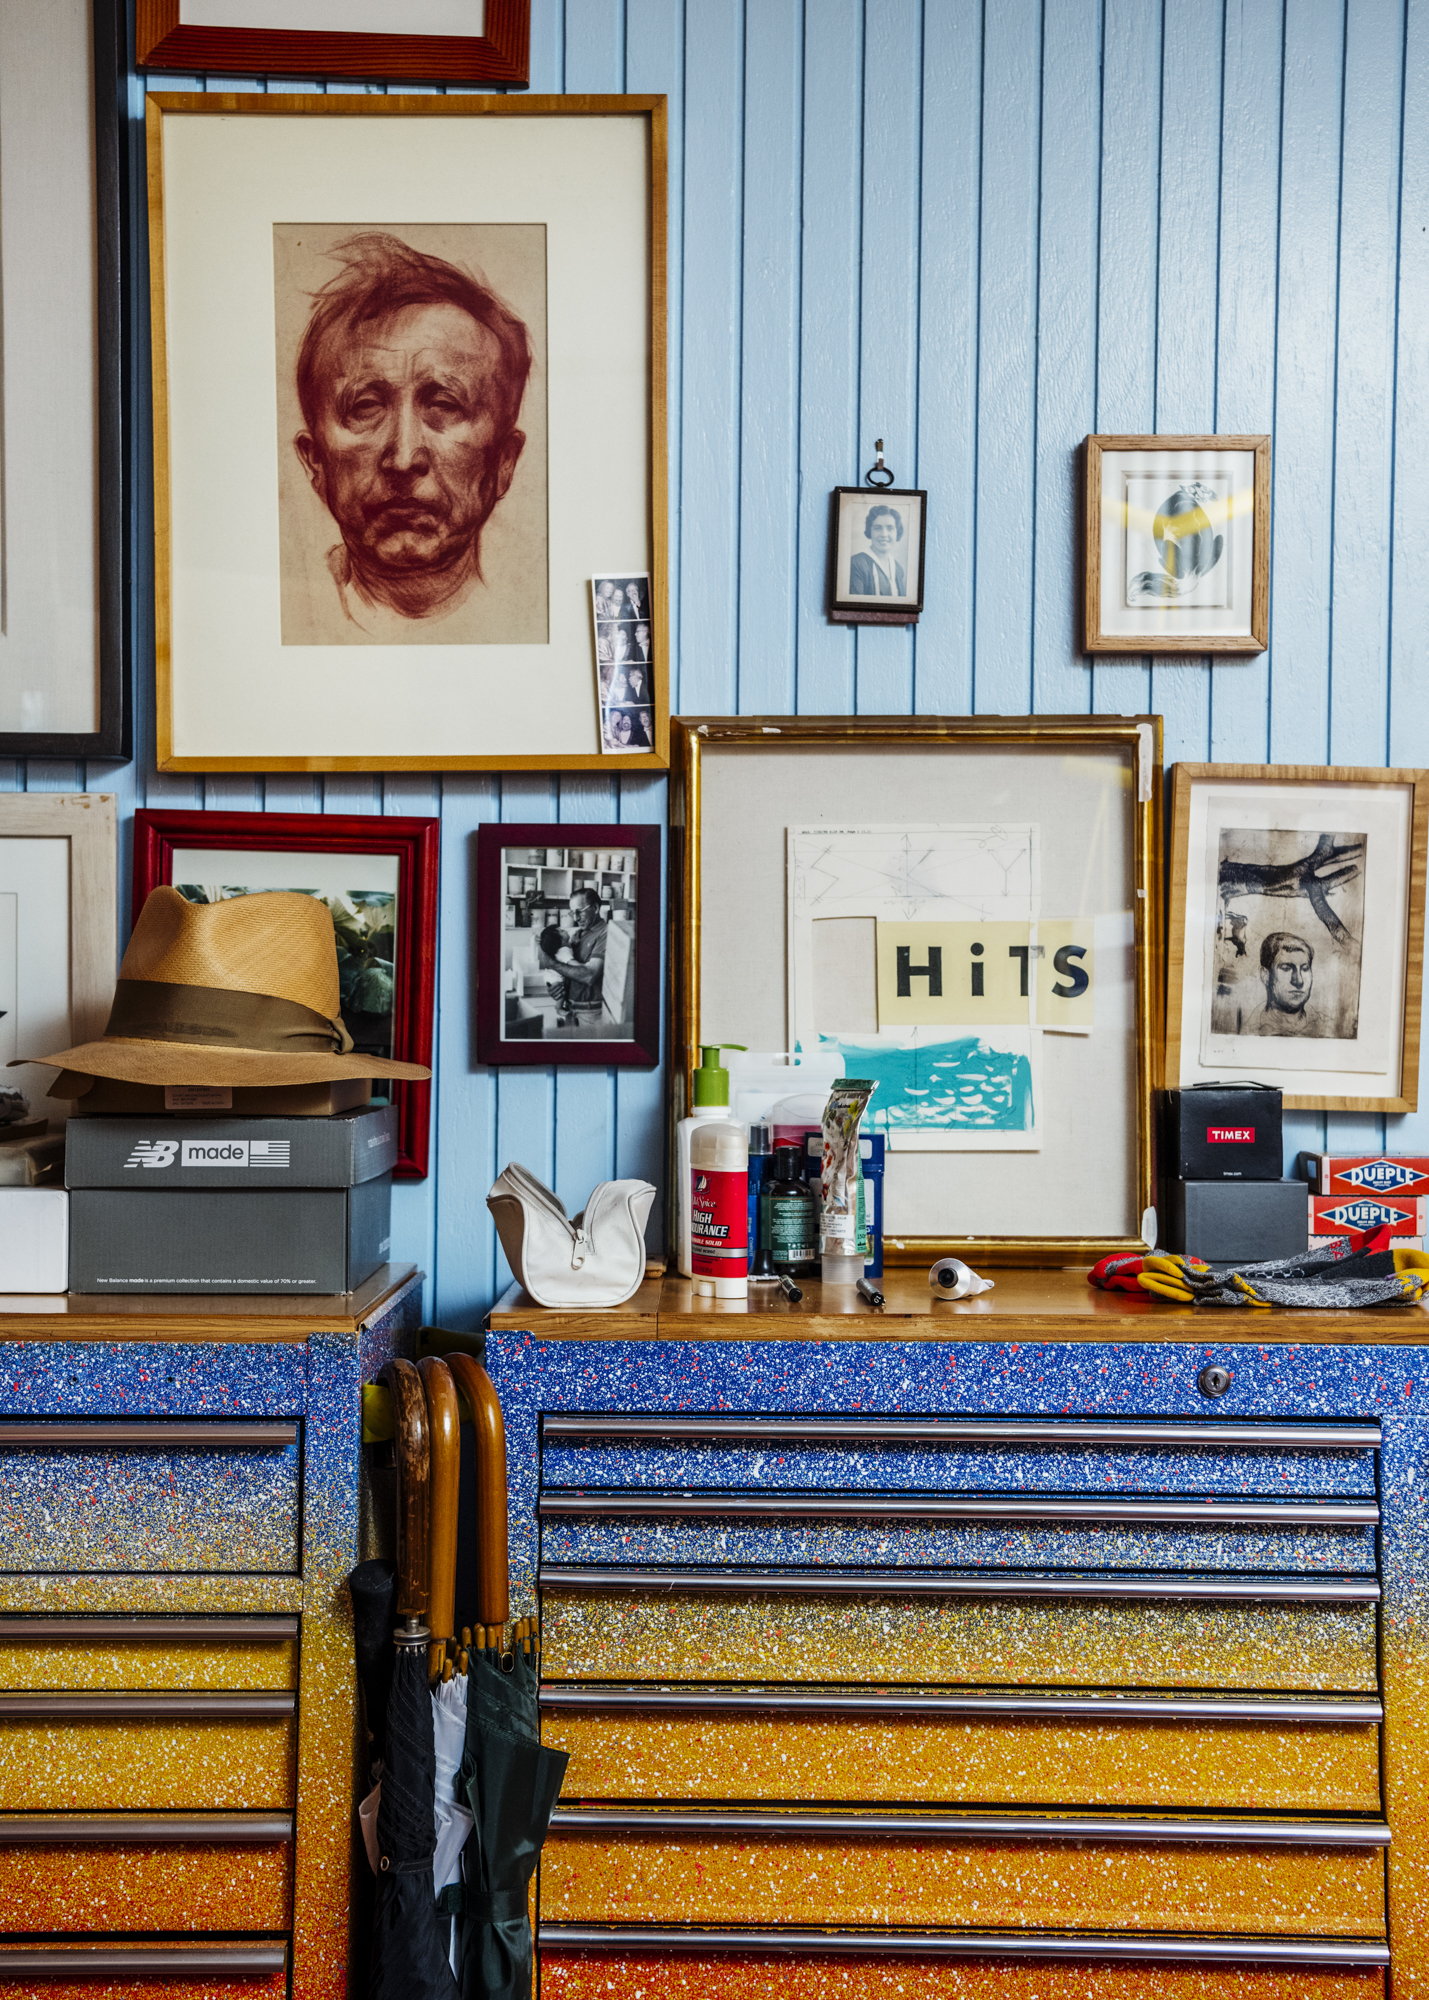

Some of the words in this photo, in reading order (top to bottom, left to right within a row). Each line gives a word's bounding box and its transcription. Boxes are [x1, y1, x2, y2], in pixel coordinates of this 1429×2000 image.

[896, 942, 1090, 998] HiTS
[1211, 1130, 1251, 1140] TIMEX
[123, 1140, 180, 1168] NB
[188, 1144, 244, 1160] made
[1351, 1167, 1414, 1187] DUEPLE
[698, 1195, 716, 1209] Spice
[692, 1208, 713, 1224] HIGH
[1334, 1206, 1398, 1227] DUEPLE
[692, 1222, 729, 1238] DURANCE
[704, 1239, 723, 1247] SOLID
